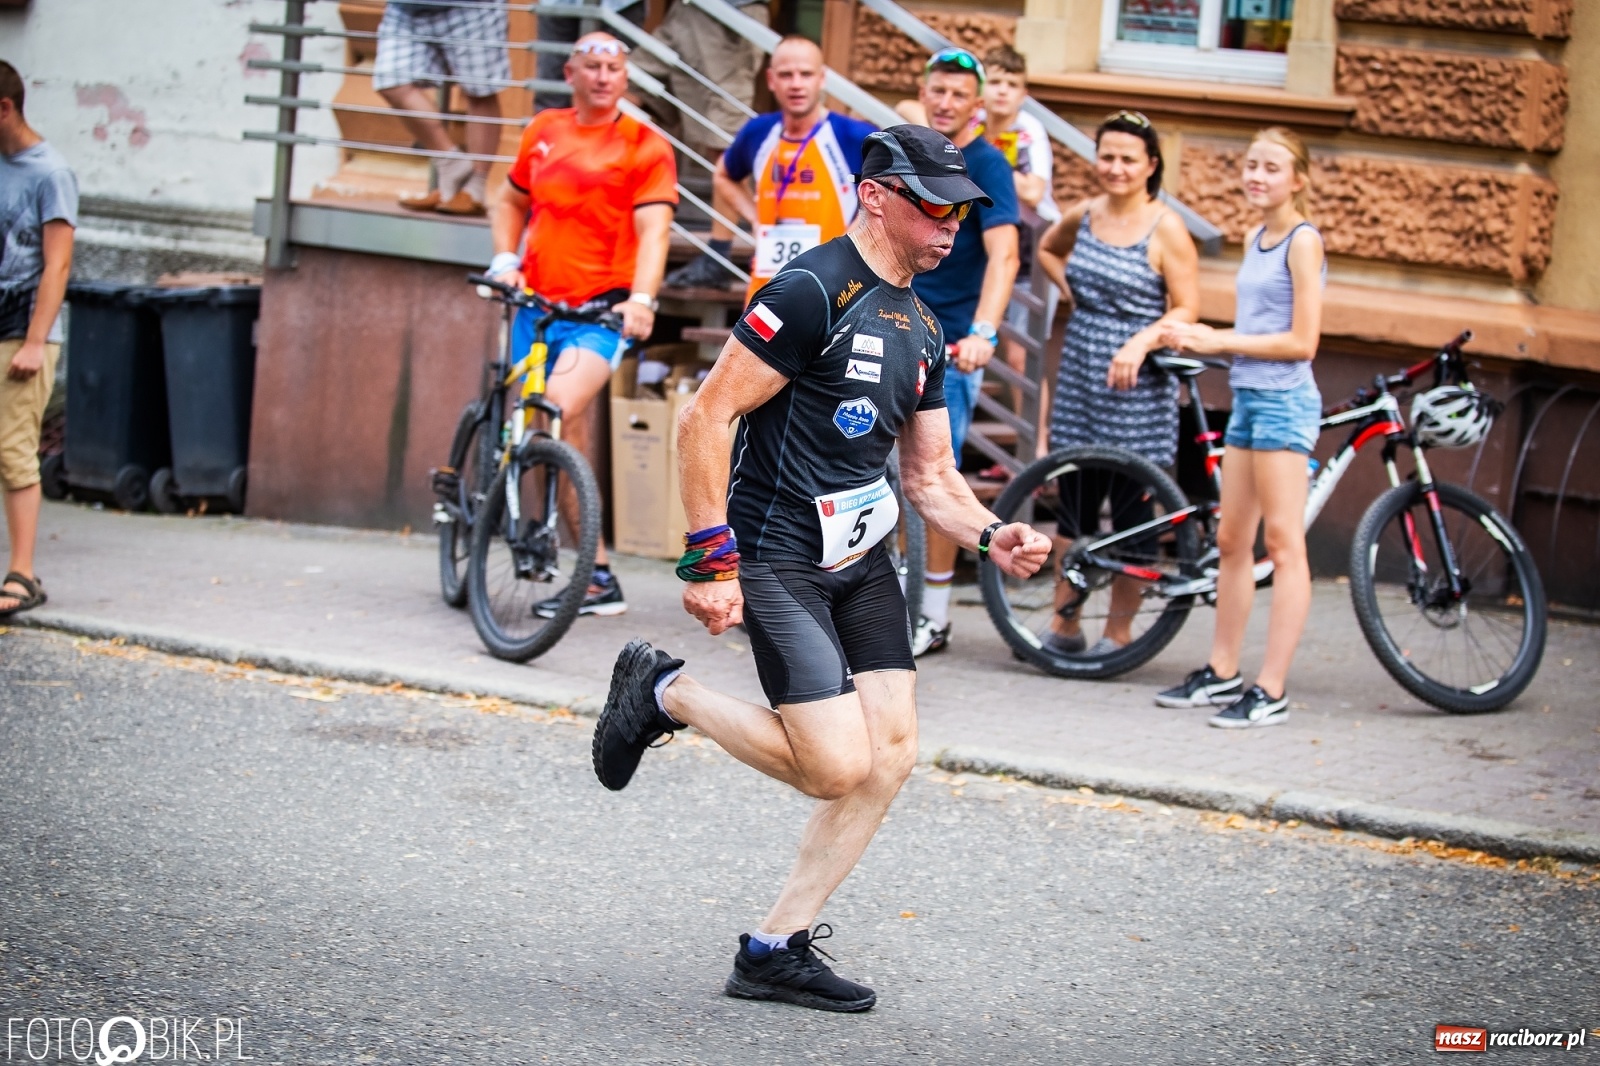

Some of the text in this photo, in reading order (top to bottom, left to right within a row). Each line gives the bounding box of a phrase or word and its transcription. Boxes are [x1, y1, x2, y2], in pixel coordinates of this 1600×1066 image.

[772, 242, 801, 264] 38
[837, 279, 863, 308] Malibu
[841, 500, 858, 510] BIEG
[848, 507, 874, 549] 5
